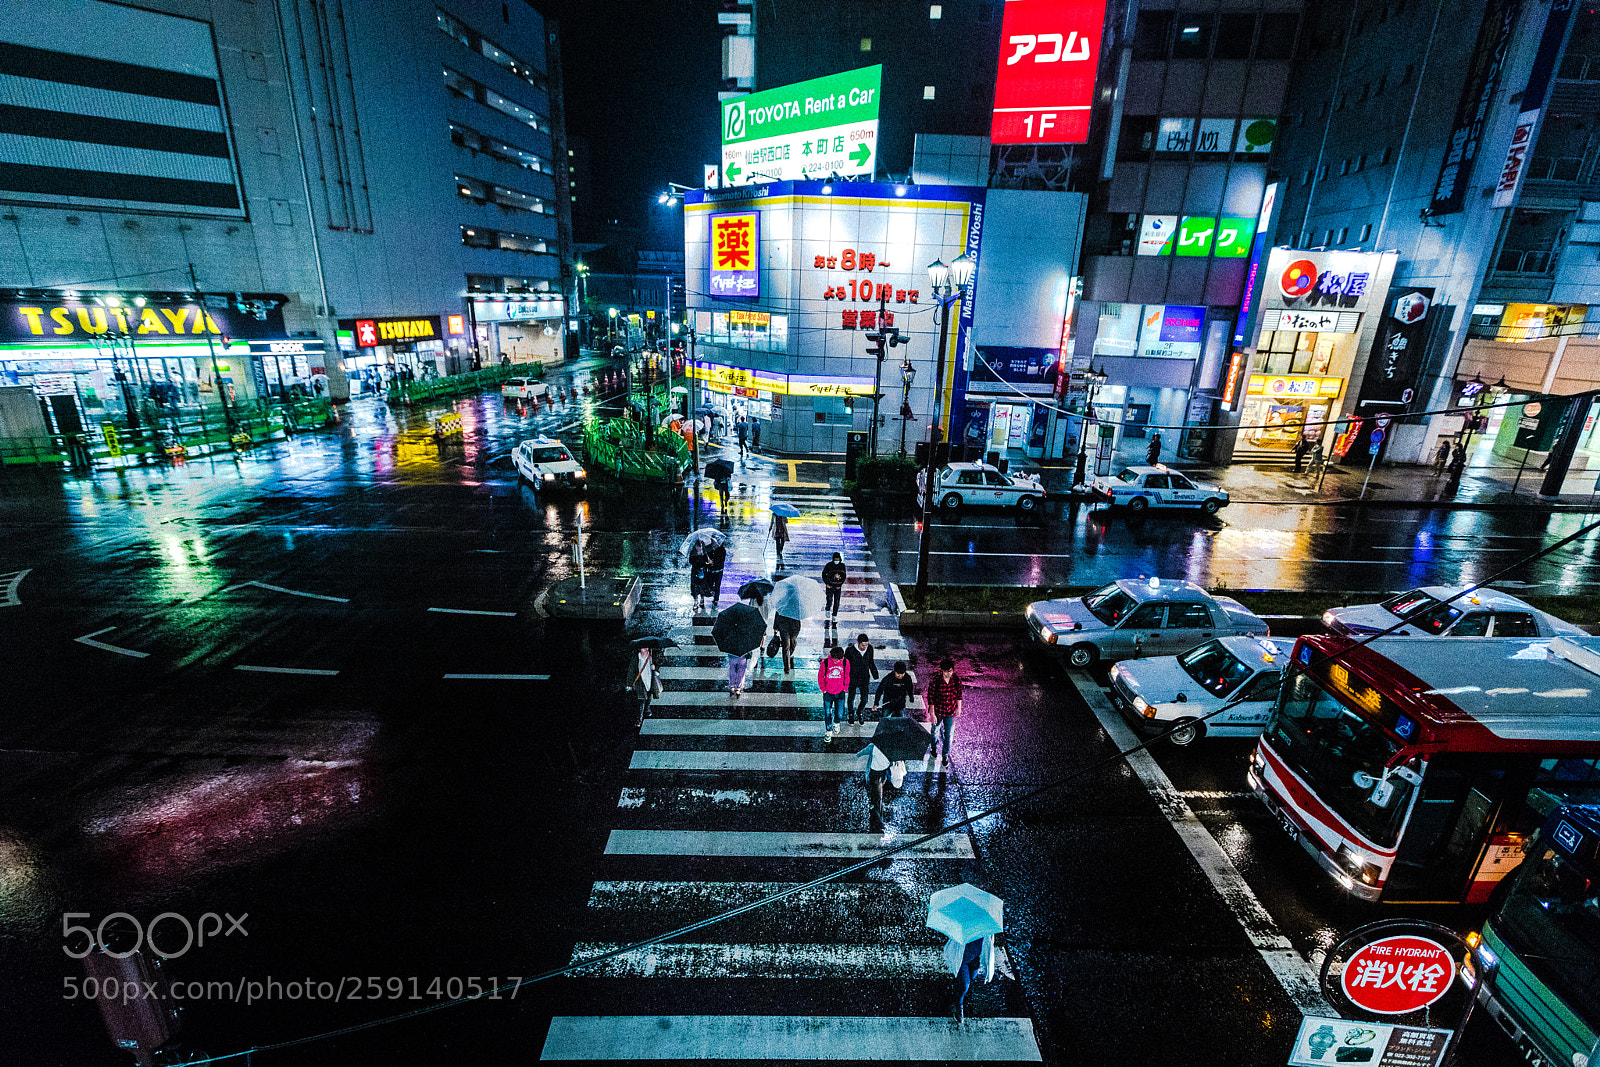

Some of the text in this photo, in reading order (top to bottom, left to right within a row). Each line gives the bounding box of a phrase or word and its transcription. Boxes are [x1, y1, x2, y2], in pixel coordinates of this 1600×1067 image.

[1007, 31, 1090, 65] アコム
[748, 87, 875, 126] TOYOTA Rent a Car
[850, 129, 874, 141] 650m
[1023, 113, 1057, 138] 1F
[744, 144, 791, 165] 仙台駅西口店
[802, 135, 844, 157] 本町店
[718, 218, 750, 268] 薬
[1179, 227, 1238, 247] レイク
[1242, 263, 1258, 312] PROMISE
[1318, 270, 1370, 297] 松屋
[19, 306, 222, 335] TSUTAYA
[378, 320, 434, 340] TSUTAYA
[1165, 318, 1201, 327] PROMISE
[1288, 380, 1315, 393] 松屋
[1370, 946, 1443, 959] FIRE HYDRANT
[1351, 958, 1445, 992] 消火栓
